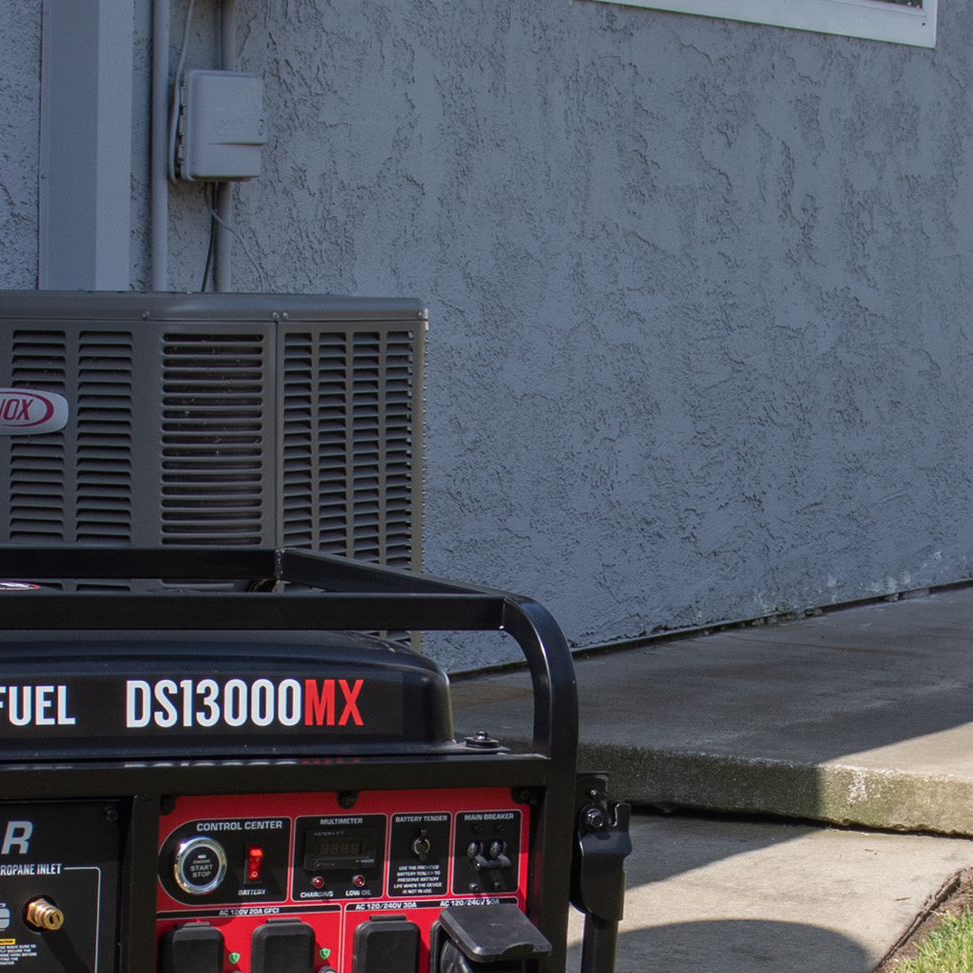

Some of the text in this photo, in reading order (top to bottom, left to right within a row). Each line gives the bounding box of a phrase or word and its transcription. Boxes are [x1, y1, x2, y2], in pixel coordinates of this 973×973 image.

[125, 677, 365, 729] DS13000MX
[196, 820, 283, 832] CONTROL CENTER
[320, 817, 363, 825] MULTIMETER
[36, 862, 62, 875] INLET
[300, 890, 334, 898] CHARGING
[356, 901, 417, 911] AC 120/240V 30A
[451, 899, 485, 907] 120/240V
[219, 906, 280, 917] AC 120V 20A GFCI
